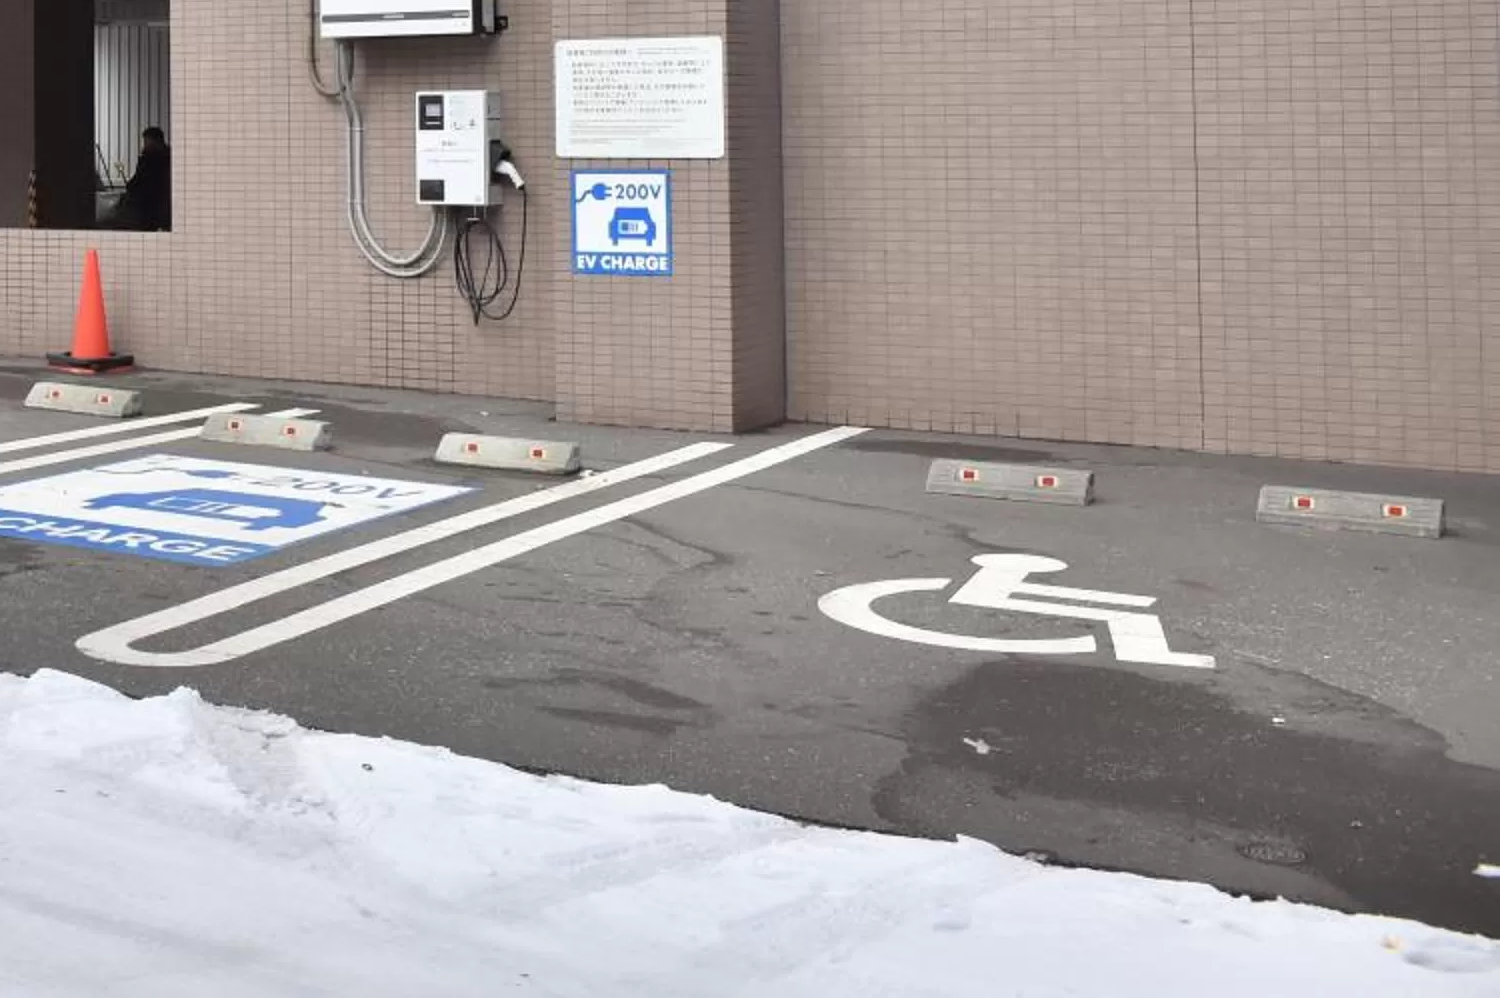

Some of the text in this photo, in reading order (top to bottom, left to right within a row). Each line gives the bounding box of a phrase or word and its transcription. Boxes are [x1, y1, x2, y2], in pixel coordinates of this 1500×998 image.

[614, 183, 661, 200] 200V
[576, 254, 669, 272] EV CHARGE
[248, 476, 427, 499] 200V
